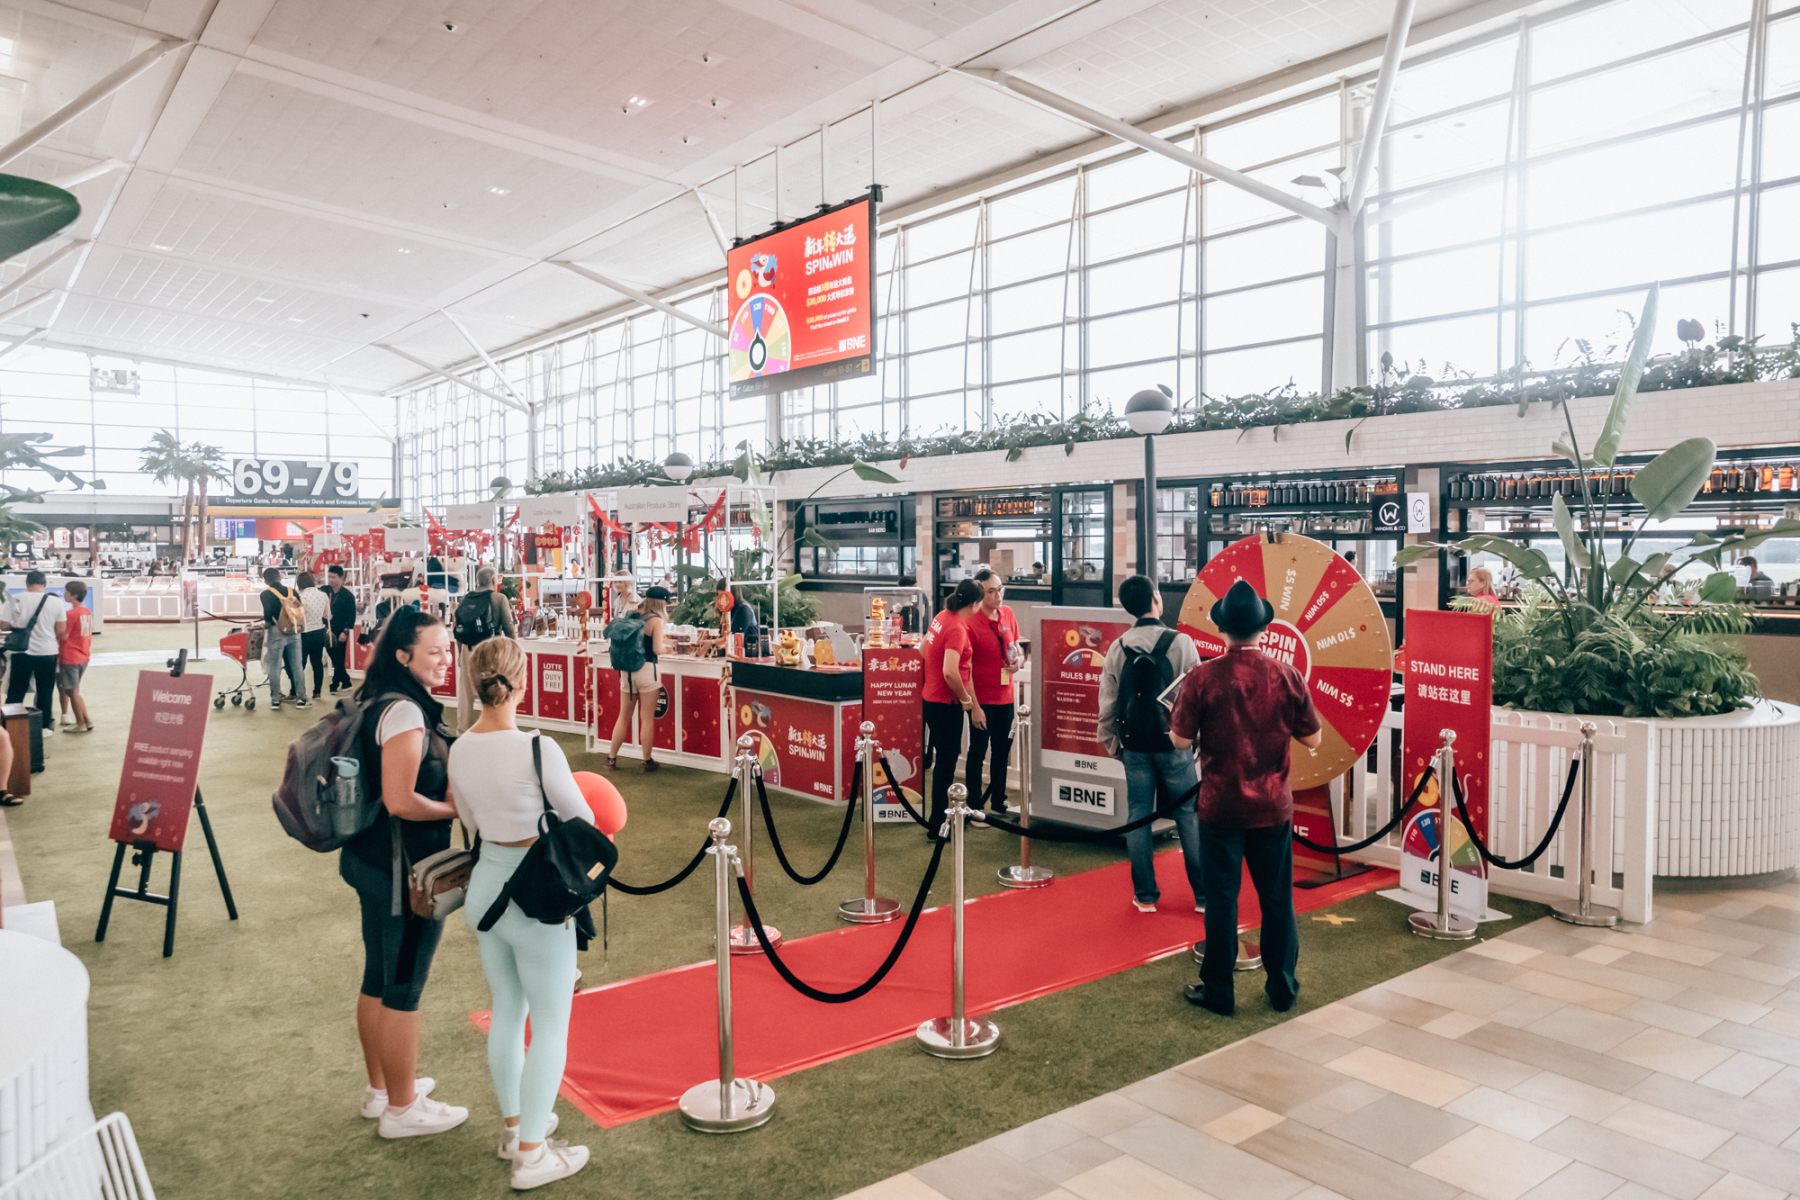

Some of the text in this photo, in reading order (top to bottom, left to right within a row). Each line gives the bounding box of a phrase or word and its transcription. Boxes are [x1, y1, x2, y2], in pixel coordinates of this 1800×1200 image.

[804, 224, 856, 258] 新年转大运
[847, 334, 866, 350] BNE
[234, 458, 358, 497] 69-79
[253, 497, 270, 505] Gates,
[624, 502, 646, 510] Australian
[646, 501, 667, 509] Produce
[1280, 568, 1297, 611] $5 WIN
[1304, 591, 1330, 621] $50 WIN
[930, 618, 943, 634] EAM
[1194, 639, 1223, 653] INSTANT
[1259, 630, 1297, 652] SPIN
[1316, 626, 1356, 650] $10 WIN
[1262, 645, 1294, 666] WIN
[543, 663, 563, 671] LOTTE
[1410, 660, 1479, 681] STAND HERE
[545, 673, 562, 682] DUTY
[1061, 671, 1083, 680] RULES
[545, 681, 562, 689] FREE
[1316, 679, 1354, 707] $5 WIN
[152, 689, 192, 705] Welcome
[1418, 683, 1471, 705] 请站在这里
[788, 725, 827, 750] 新年转大运
[134, 742, 193, 759] FREE product sampling
[160, 759, 171, 769] right
[1081, 760, 1098, 771] BNE
[820, 783, 833, 794] BNE
[1074, 788, 1106, 808] BNE
[888, 810, 908, 818] BNE
[1421, 817, 1431, 828] $20
[1409, 828, 1418, 842] $10
